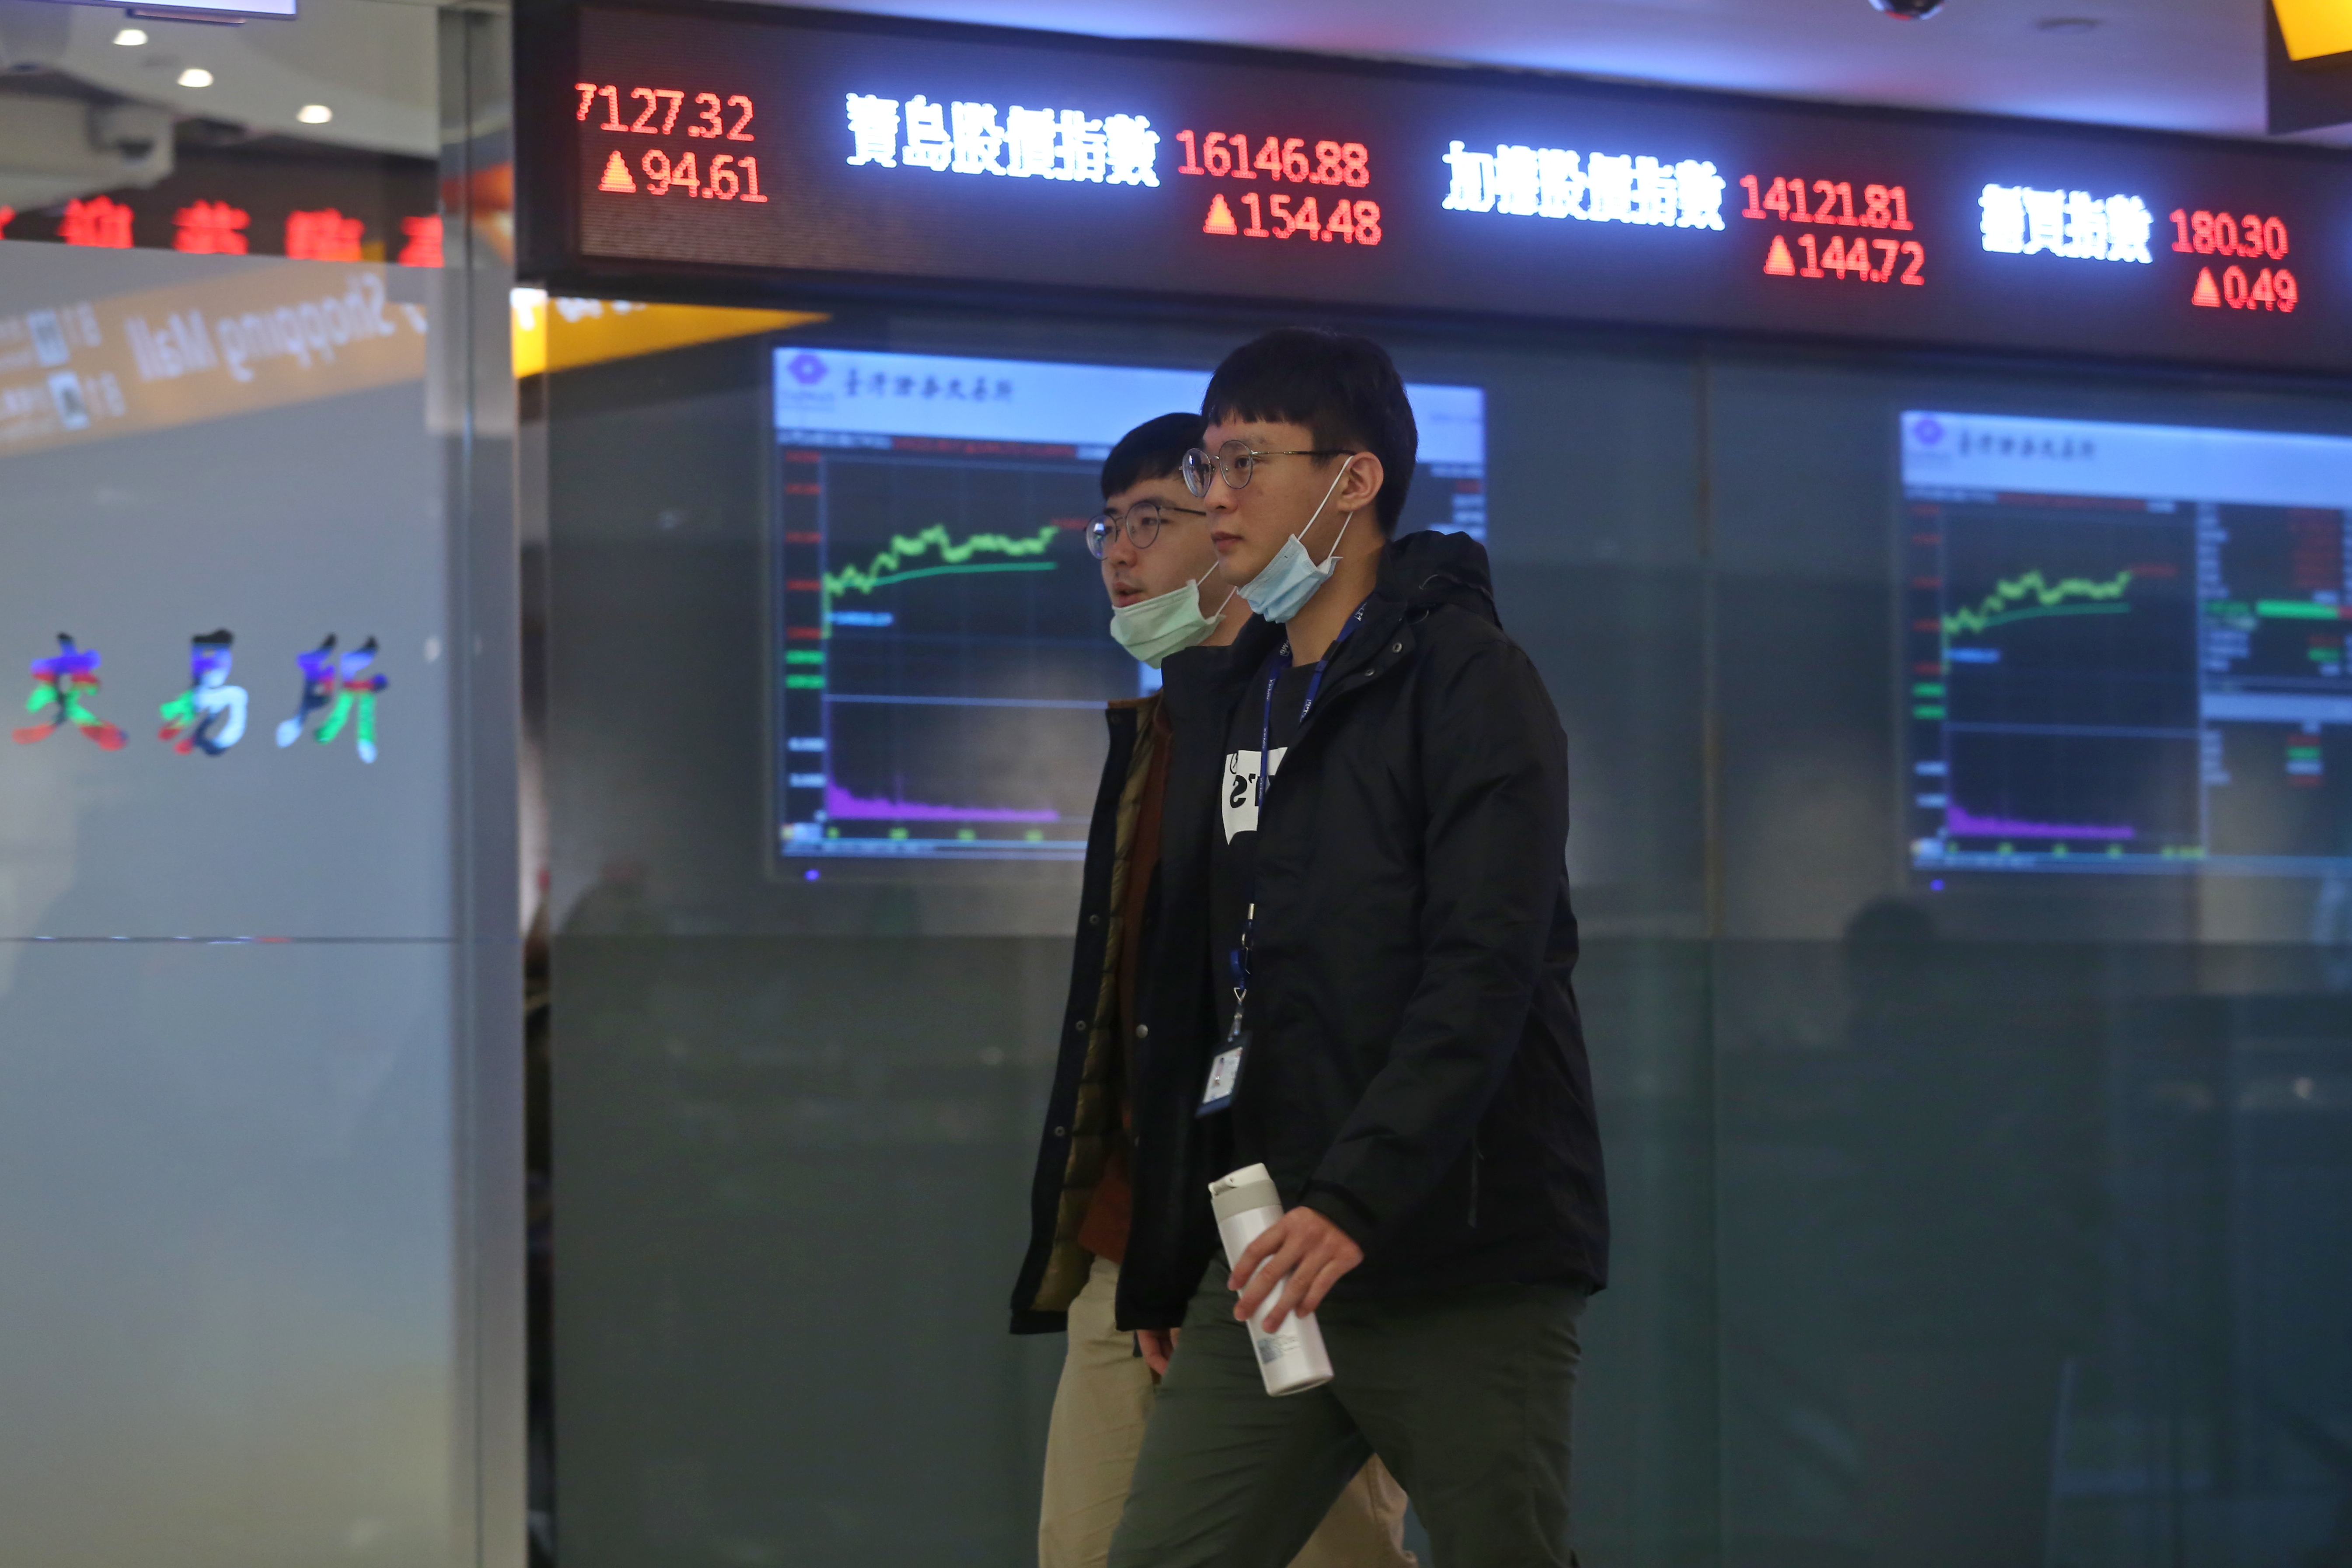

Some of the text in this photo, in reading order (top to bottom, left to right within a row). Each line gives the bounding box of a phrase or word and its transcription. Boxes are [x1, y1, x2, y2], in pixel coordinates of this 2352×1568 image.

[575, 82, 754, 142] 7127.32
[641, 149, 768, 203] 94.61
[1176, 130, 1370, 188] 16146.88
[1241, 192, 1382, 245] 154.48
[1740, 175, 1914, 231] 14121.81
[1798, 234, 1924, 285] 144.72
[2169, 209, 2288, 260] 180.30
[2223, 265, 2298, 312] 0.49
[11, 628, 388, 764] 交易所
